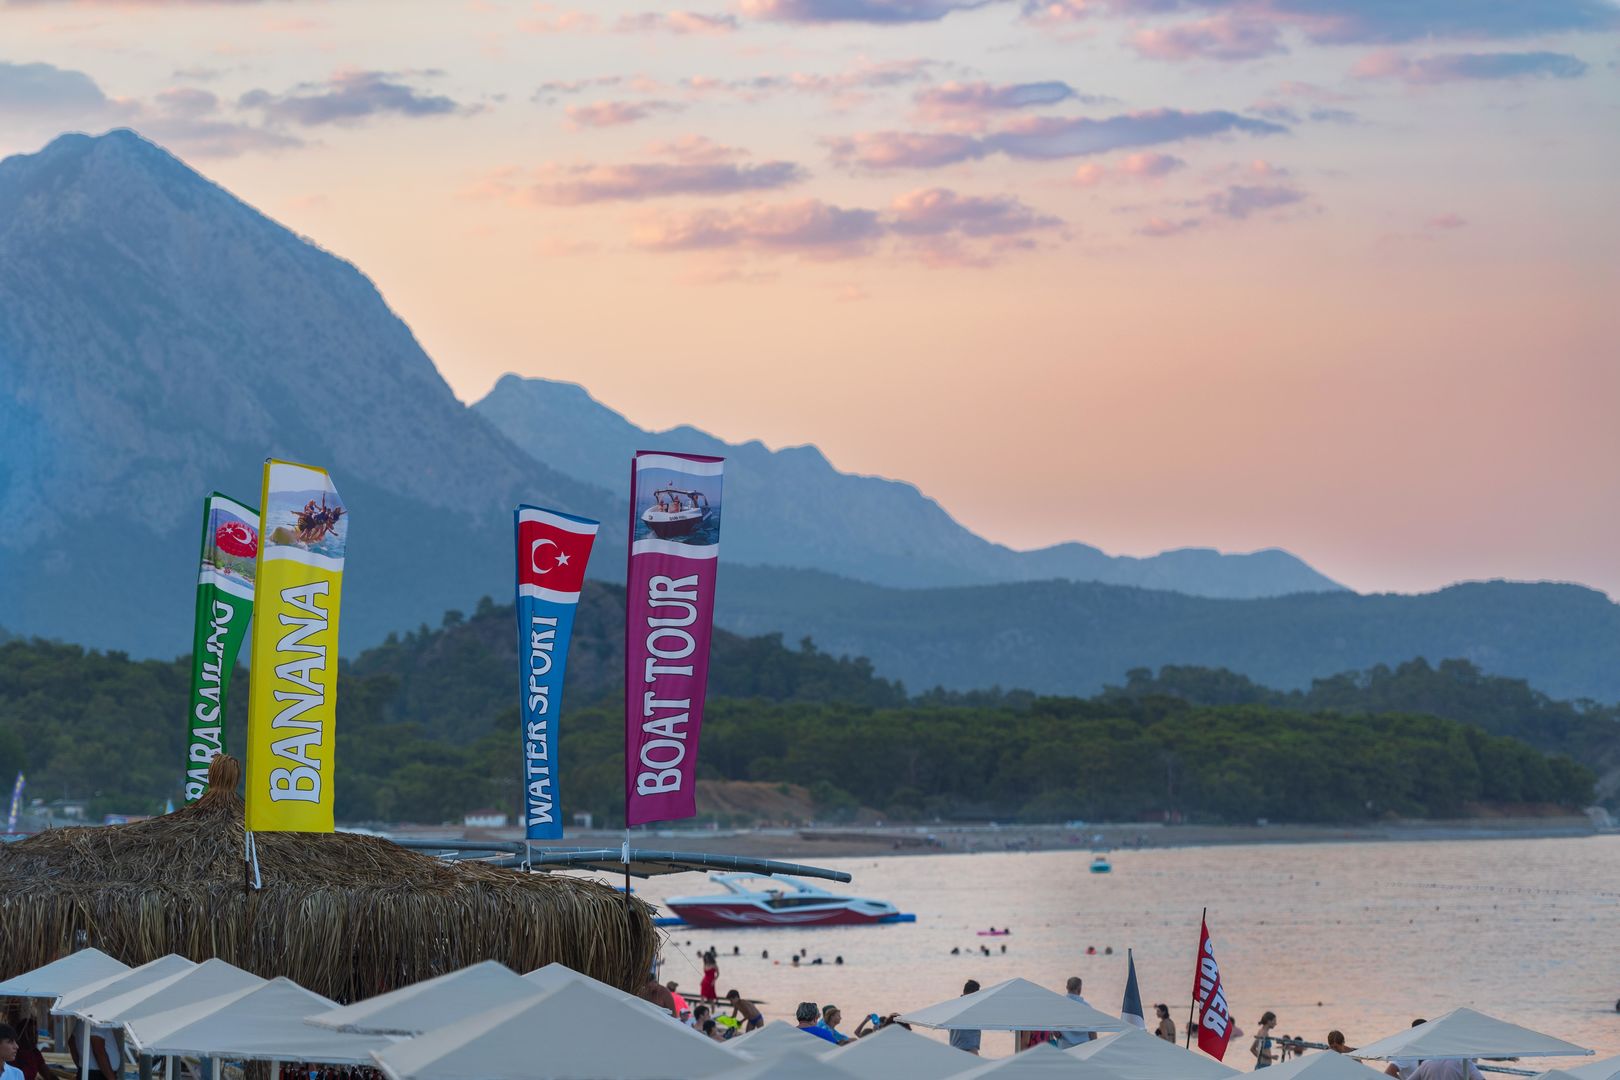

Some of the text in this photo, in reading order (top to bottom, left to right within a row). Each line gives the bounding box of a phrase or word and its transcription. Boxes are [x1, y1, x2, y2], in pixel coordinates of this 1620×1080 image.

[269, 580, 329, 804] BANANA
[527, 720, 553, 827] WATER
[636, 574, 699, 796] BOAT TOUR
